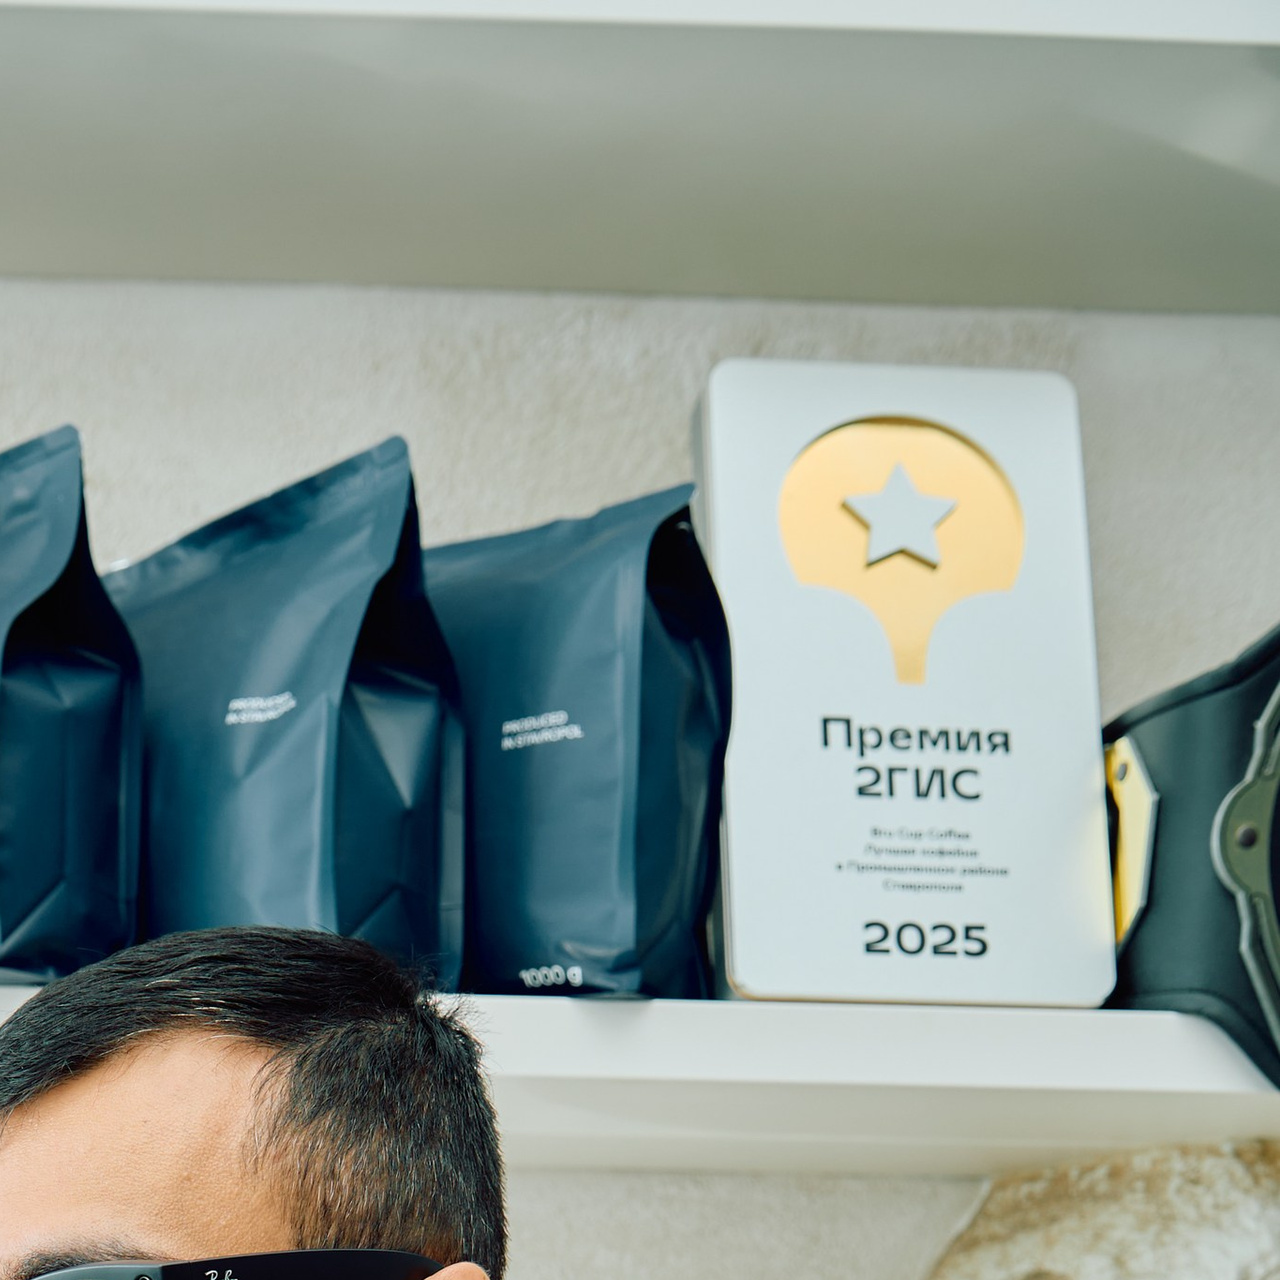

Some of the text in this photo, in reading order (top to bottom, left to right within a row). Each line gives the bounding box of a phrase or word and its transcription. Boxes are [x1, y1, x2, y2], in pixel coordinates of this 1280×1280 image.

[822, 717, 1010, 757] Премия
[856, 765, 981, 800] 2ГИС
[864, 921, 989, 957] 2025
[519, 964, 583, 988] 1000 g
